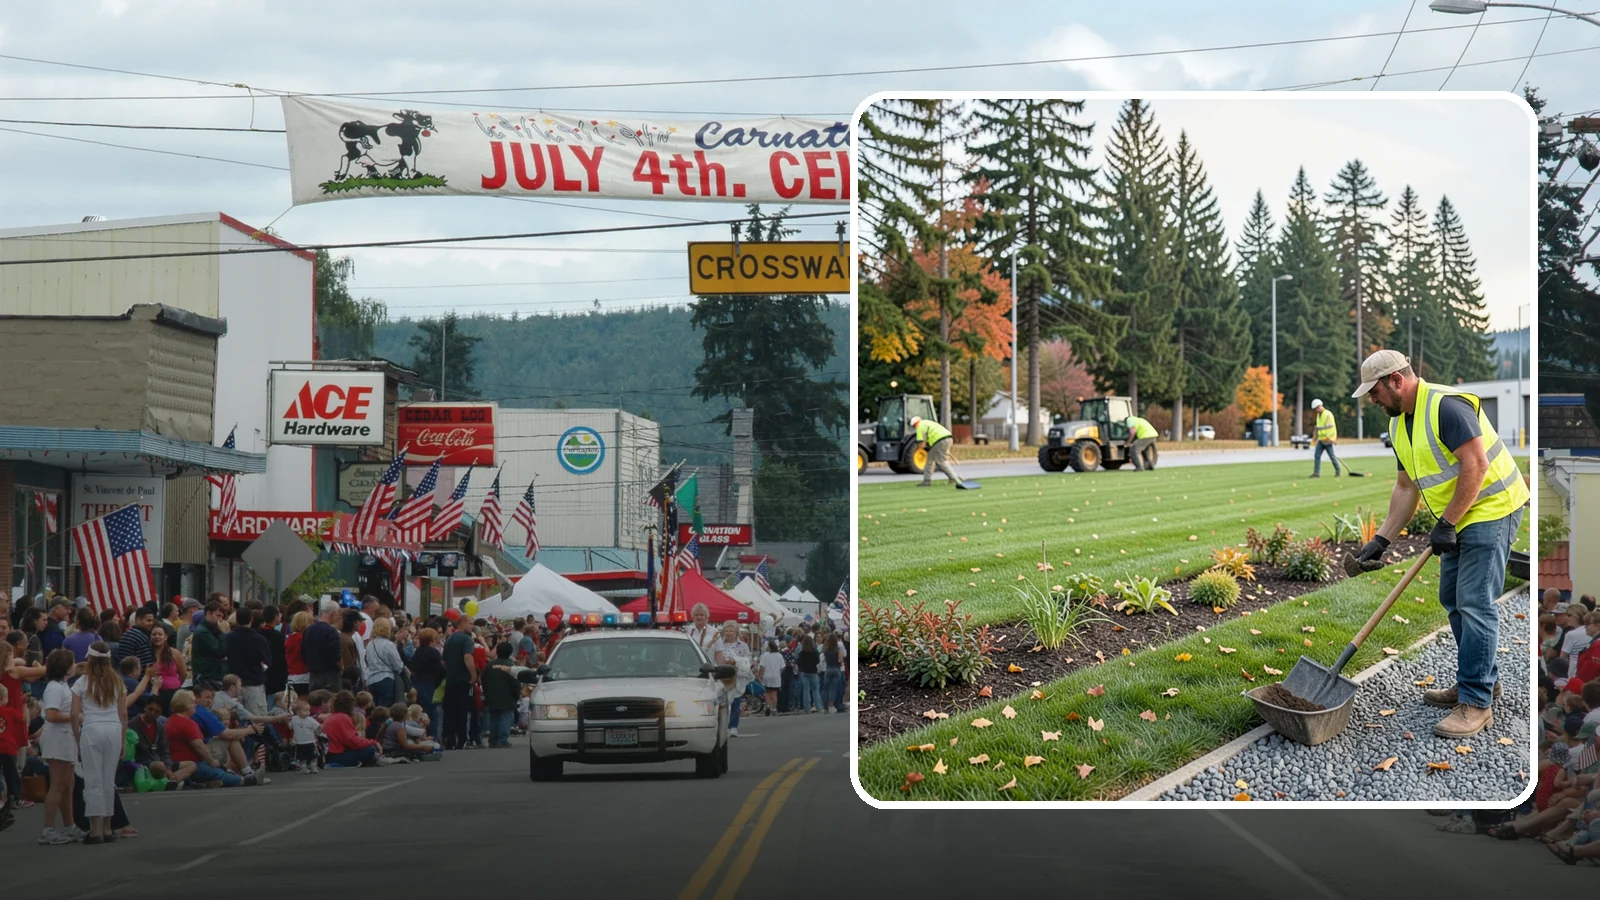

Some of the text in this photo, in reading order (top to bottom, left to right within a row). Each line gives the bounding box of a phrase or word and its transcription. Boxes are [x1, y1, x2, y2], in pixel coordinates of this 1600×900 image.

[481, 141, 605, 192] JULY
[632, 150, 746, 198] 4th.
[697, 254, 850, 280] CROSSWA
[283, 380, 373, 420] ACE
[406, 409, 452, 422] CEDAR
[283, 421, 370, 436] Hardware
[416, 428, 477, 447] Coca-Cola
[83, 484, 155, 495] St. Vincent de Paul
[688, 526, 741, 535] CRNATION
[699, 535, 730, 543] GLASS
